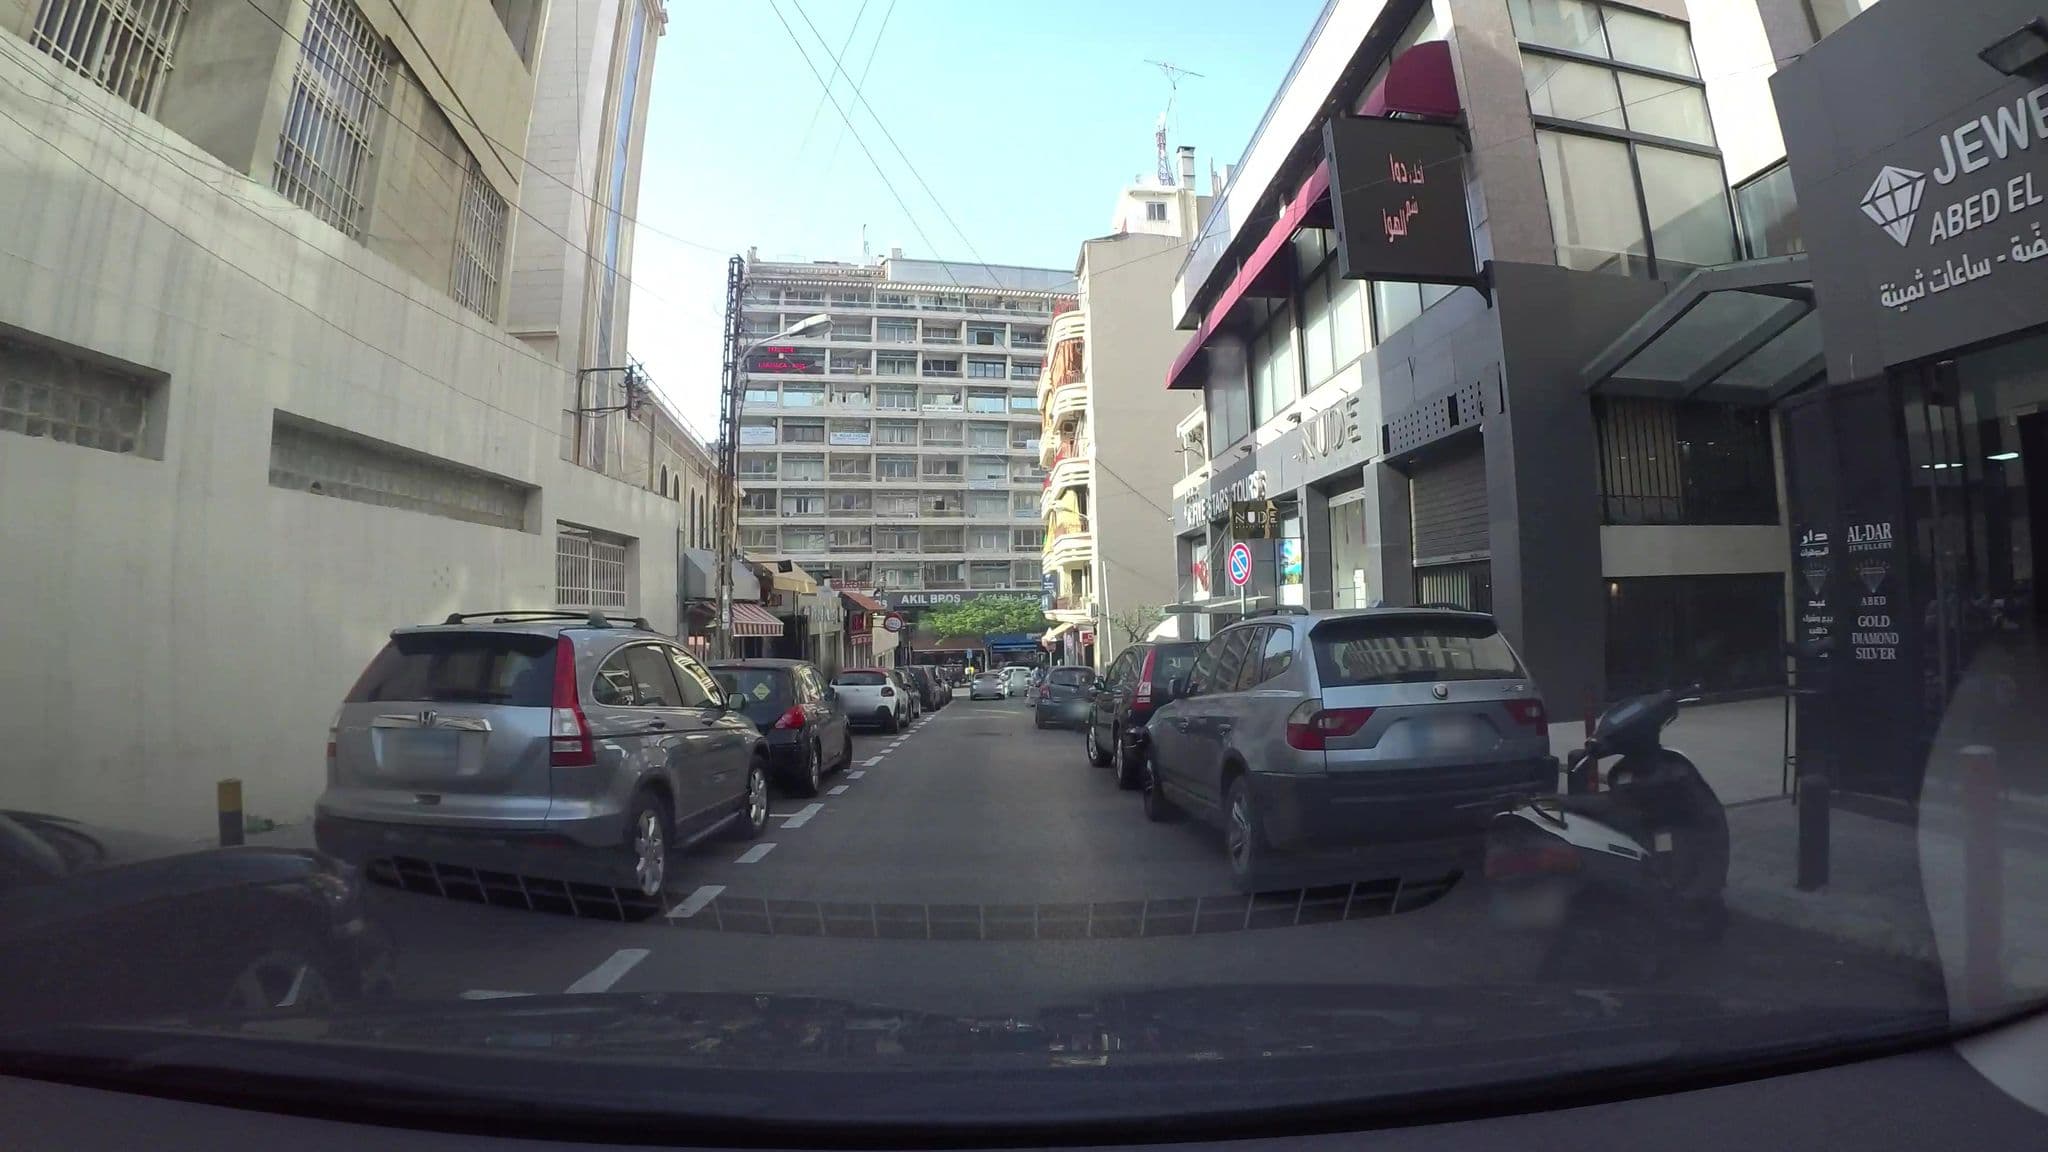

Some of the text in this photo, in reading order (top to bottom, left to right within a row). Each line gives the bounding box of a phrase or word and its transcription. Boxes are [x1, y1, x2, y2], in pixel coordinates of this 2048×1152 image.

[1930, 172, 2044, 245] ABED EL
[1929, 254, 1991, 293] ساعات
[1880, 268, 1926, 312] ثمينة
[1300, 397, 1361, 464] NUDE
[1235, 511, 1278, 524] NUDE
[1802, 529, 1828, 544] دار
[1847, 522, 1892, 543] AL-DAR
[901, 594, 961, 605] AKIL BROS
[1861, 596, 1886, 606] ABED
[1857, 615, 1890, 627] GOLD
[1852, 632, 1899, 644] DIAMOND
[1855, 647, 1896, 660] SILVER
